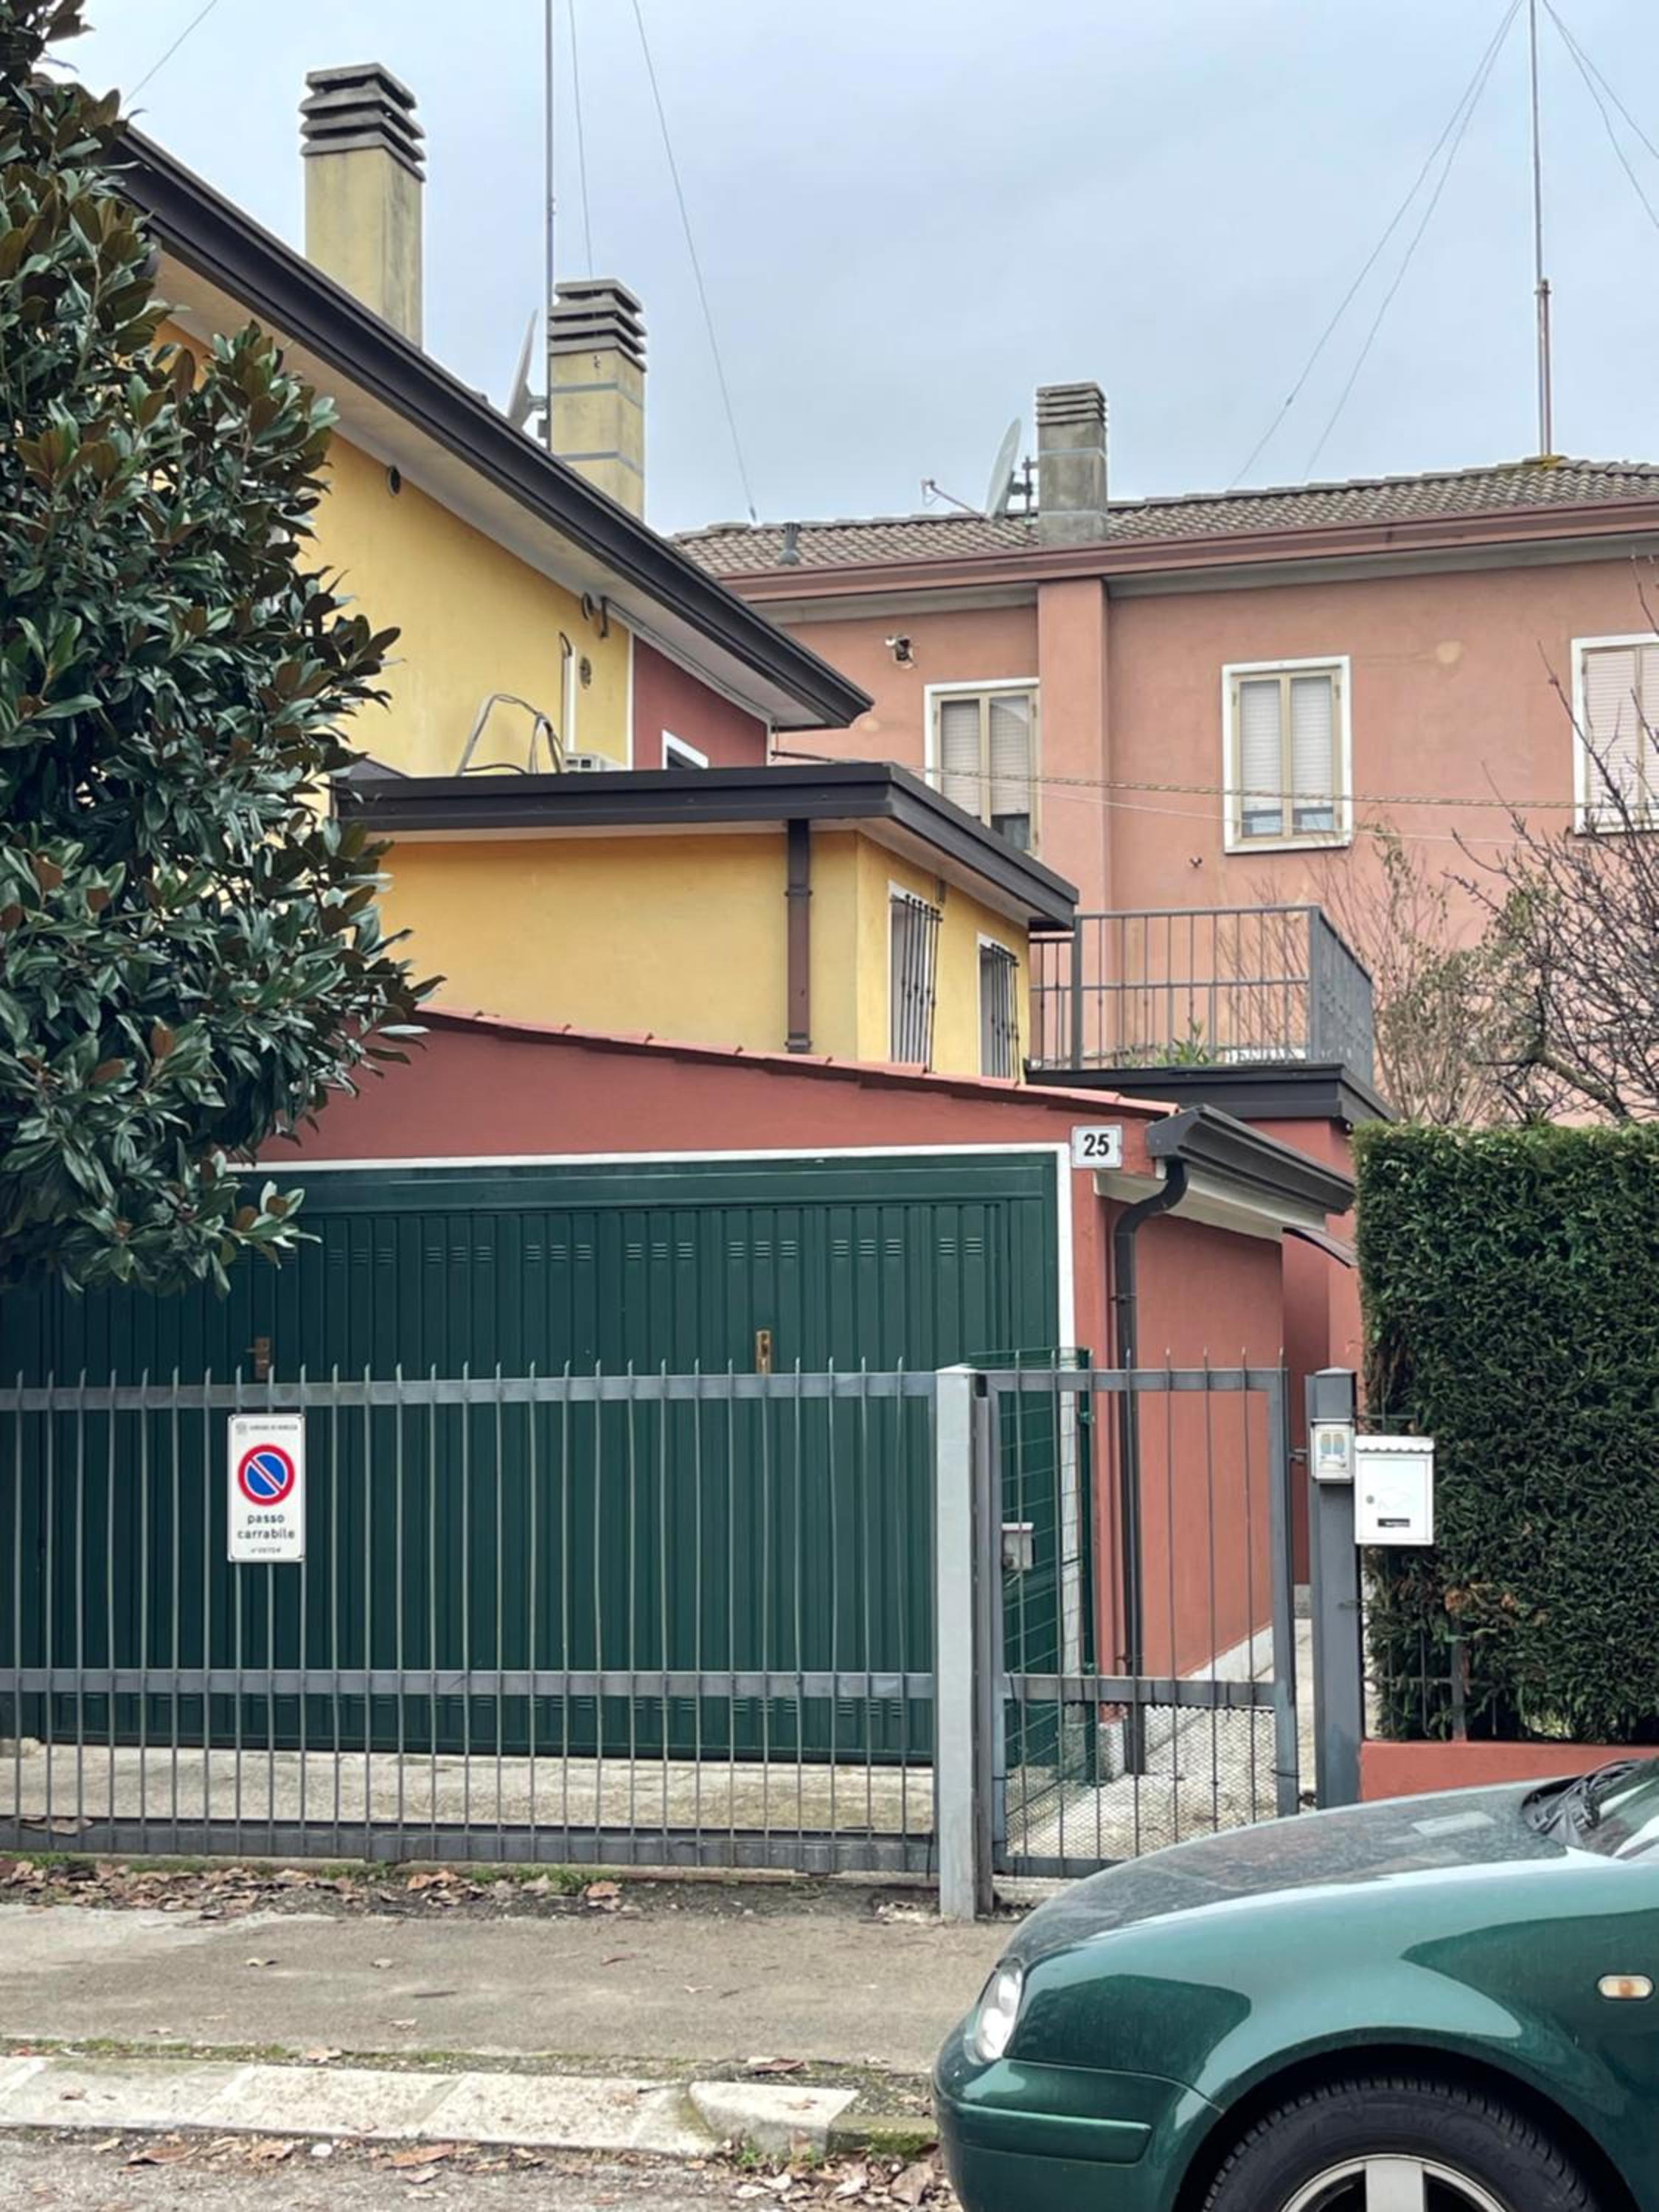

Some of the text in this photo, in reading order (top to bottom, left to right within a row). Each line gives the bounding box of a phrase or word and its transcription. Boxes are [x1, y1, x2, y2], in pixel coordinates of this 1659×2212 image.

[1084, 1133, 1110, 1156] 25
[247, 1514, 285, 1526] passo
[237, 1528, 296, 1540] carrabile
